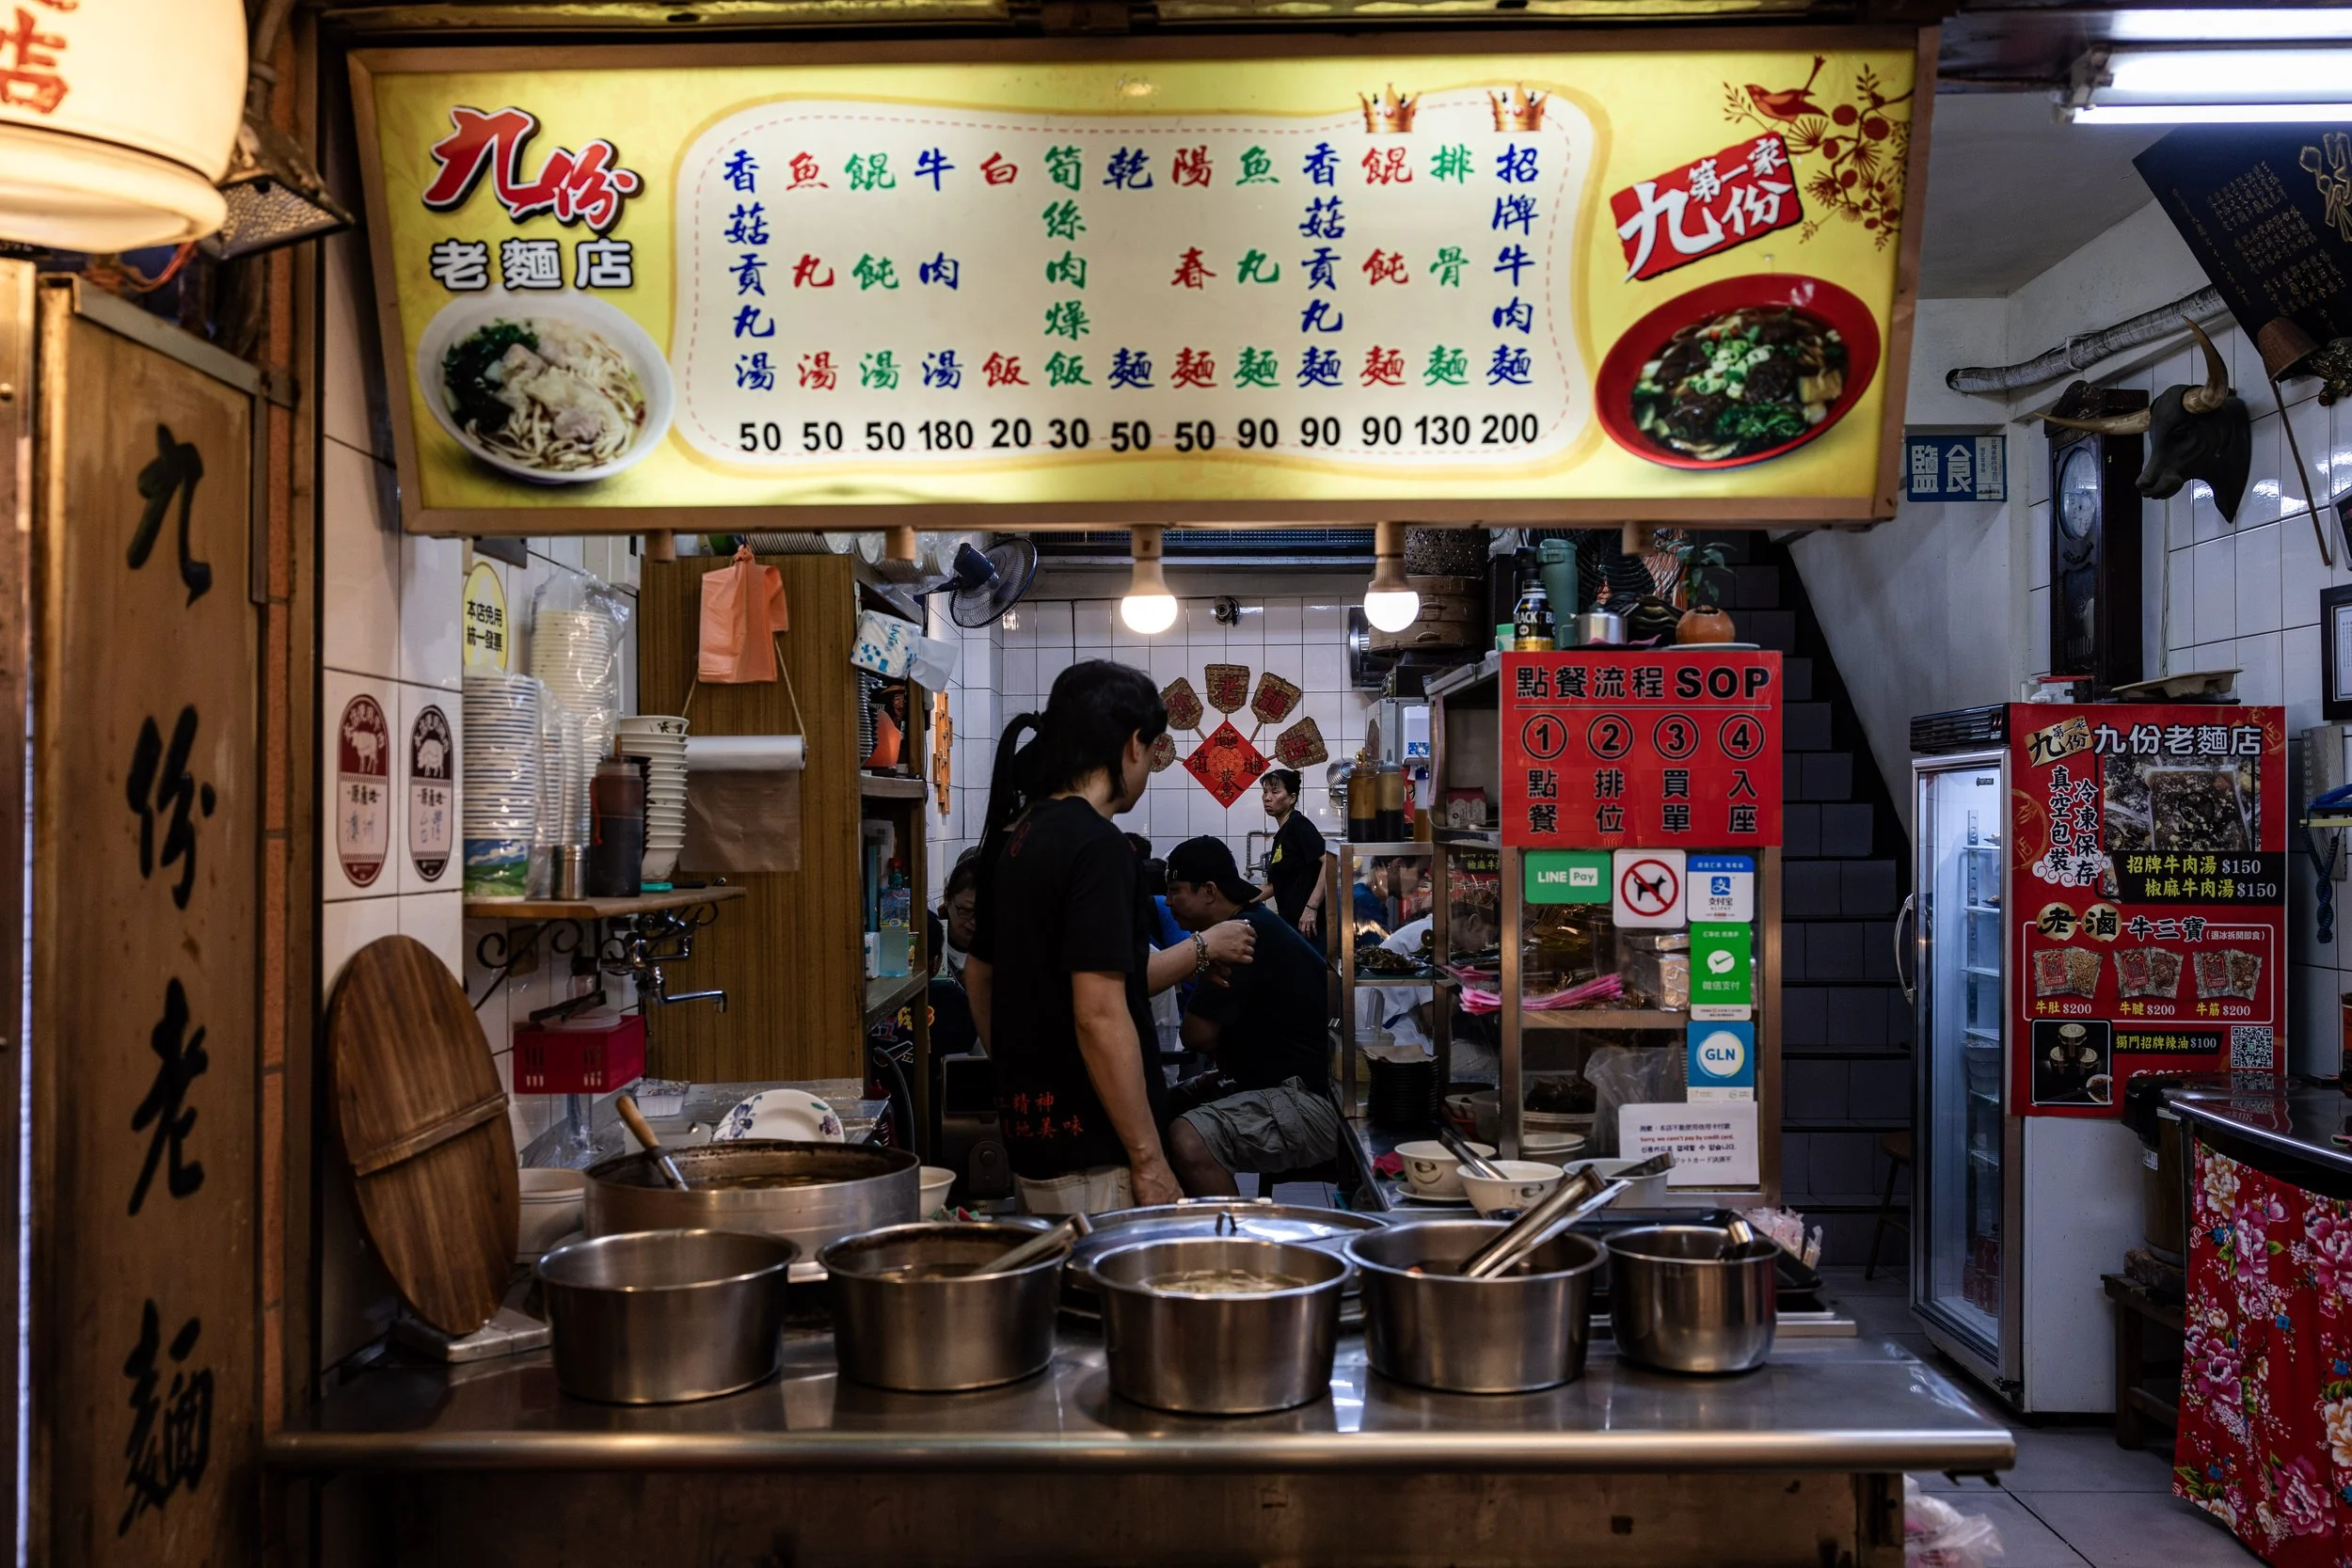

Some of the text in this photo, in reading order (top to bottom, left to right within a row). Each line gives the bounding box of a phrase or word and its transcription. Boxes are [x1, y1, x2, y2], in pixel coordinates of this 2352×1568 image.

[422, 105, 644, 235] 九份
[1688, 136, 1788, 204] 第一家
[1617, 179, 1794, 282] 九份
[430, 238, 634, 291] 老麵店
[724, 150, 776, 391] 香菇貢丸湯
[787, 151, 838, 391] 魚丸湯
[844, 151, 900, 390] 餛飩湯
[914, 147, 963, 390] 牛肉湯
[979, 151, 1031, 388] 白飯
[1041, 145, 1094, 388] 筍絲肉燥飯
[1103, 146, 1155, 390] 乾麵
[1170, 145, 1217, 389] 陽春麵
[1233, 146, 1281, 388] 魚丸麵
[1296, 142, 1346, 388] 香菇貢丸麵
[1359, 146, 1414, 388] 餛飩麵
[1422, 143, 1475, 387] 排骨麵
[1486, 142, 1539, 387] 招牌牛肉麵
[739, 413, 1539, 452] 50 50 50 180 20 30 50 50 90 90 90 130 200
[1517, 666, 1771, 700] 點餐流程 SOP
[2028, 731, 2090, 768] 九份
[2053, 718, 2087, 740] 第一家
[2093, 723, 2263, 756] 九份老麵店
[1528, 768, 1558, 833] 點餐
[1595, 768, 1625, 833] 排位
[1661, 768, 1691, 833] 買單
[1727, 769, 1757, 833] 入座
[2049, 766, 2073, 873] 真空包裝
[2074, 779, 2098, 886] 冷凍保存
[1537, 870, 1596, 885] LINE Pay
[2126, 855, 2262, 876] 招牌牛肉湯 $150
[2144, 879, 2277, 898] 椒麻牛肉湯 $150
[1708, 897, 1733, 906] 支付宝
[2128, 916, 2207, 942] 牛三寶
[118, 423, 216, 1539] 九份老麵
[1702, 981, 1740, 990] 微信支付
[2035, 1001, 2092, 1015] 牛肚 $200
[2120, 1002, 2175, 1016] 牛腱 $200
[2196, 1003, 2251, 1017] 牛筋 $200
[1705, 1049, 1736, 1061] GLN
[2115, 1036, 2217, 1051] 獨門招牌辣油 $100
